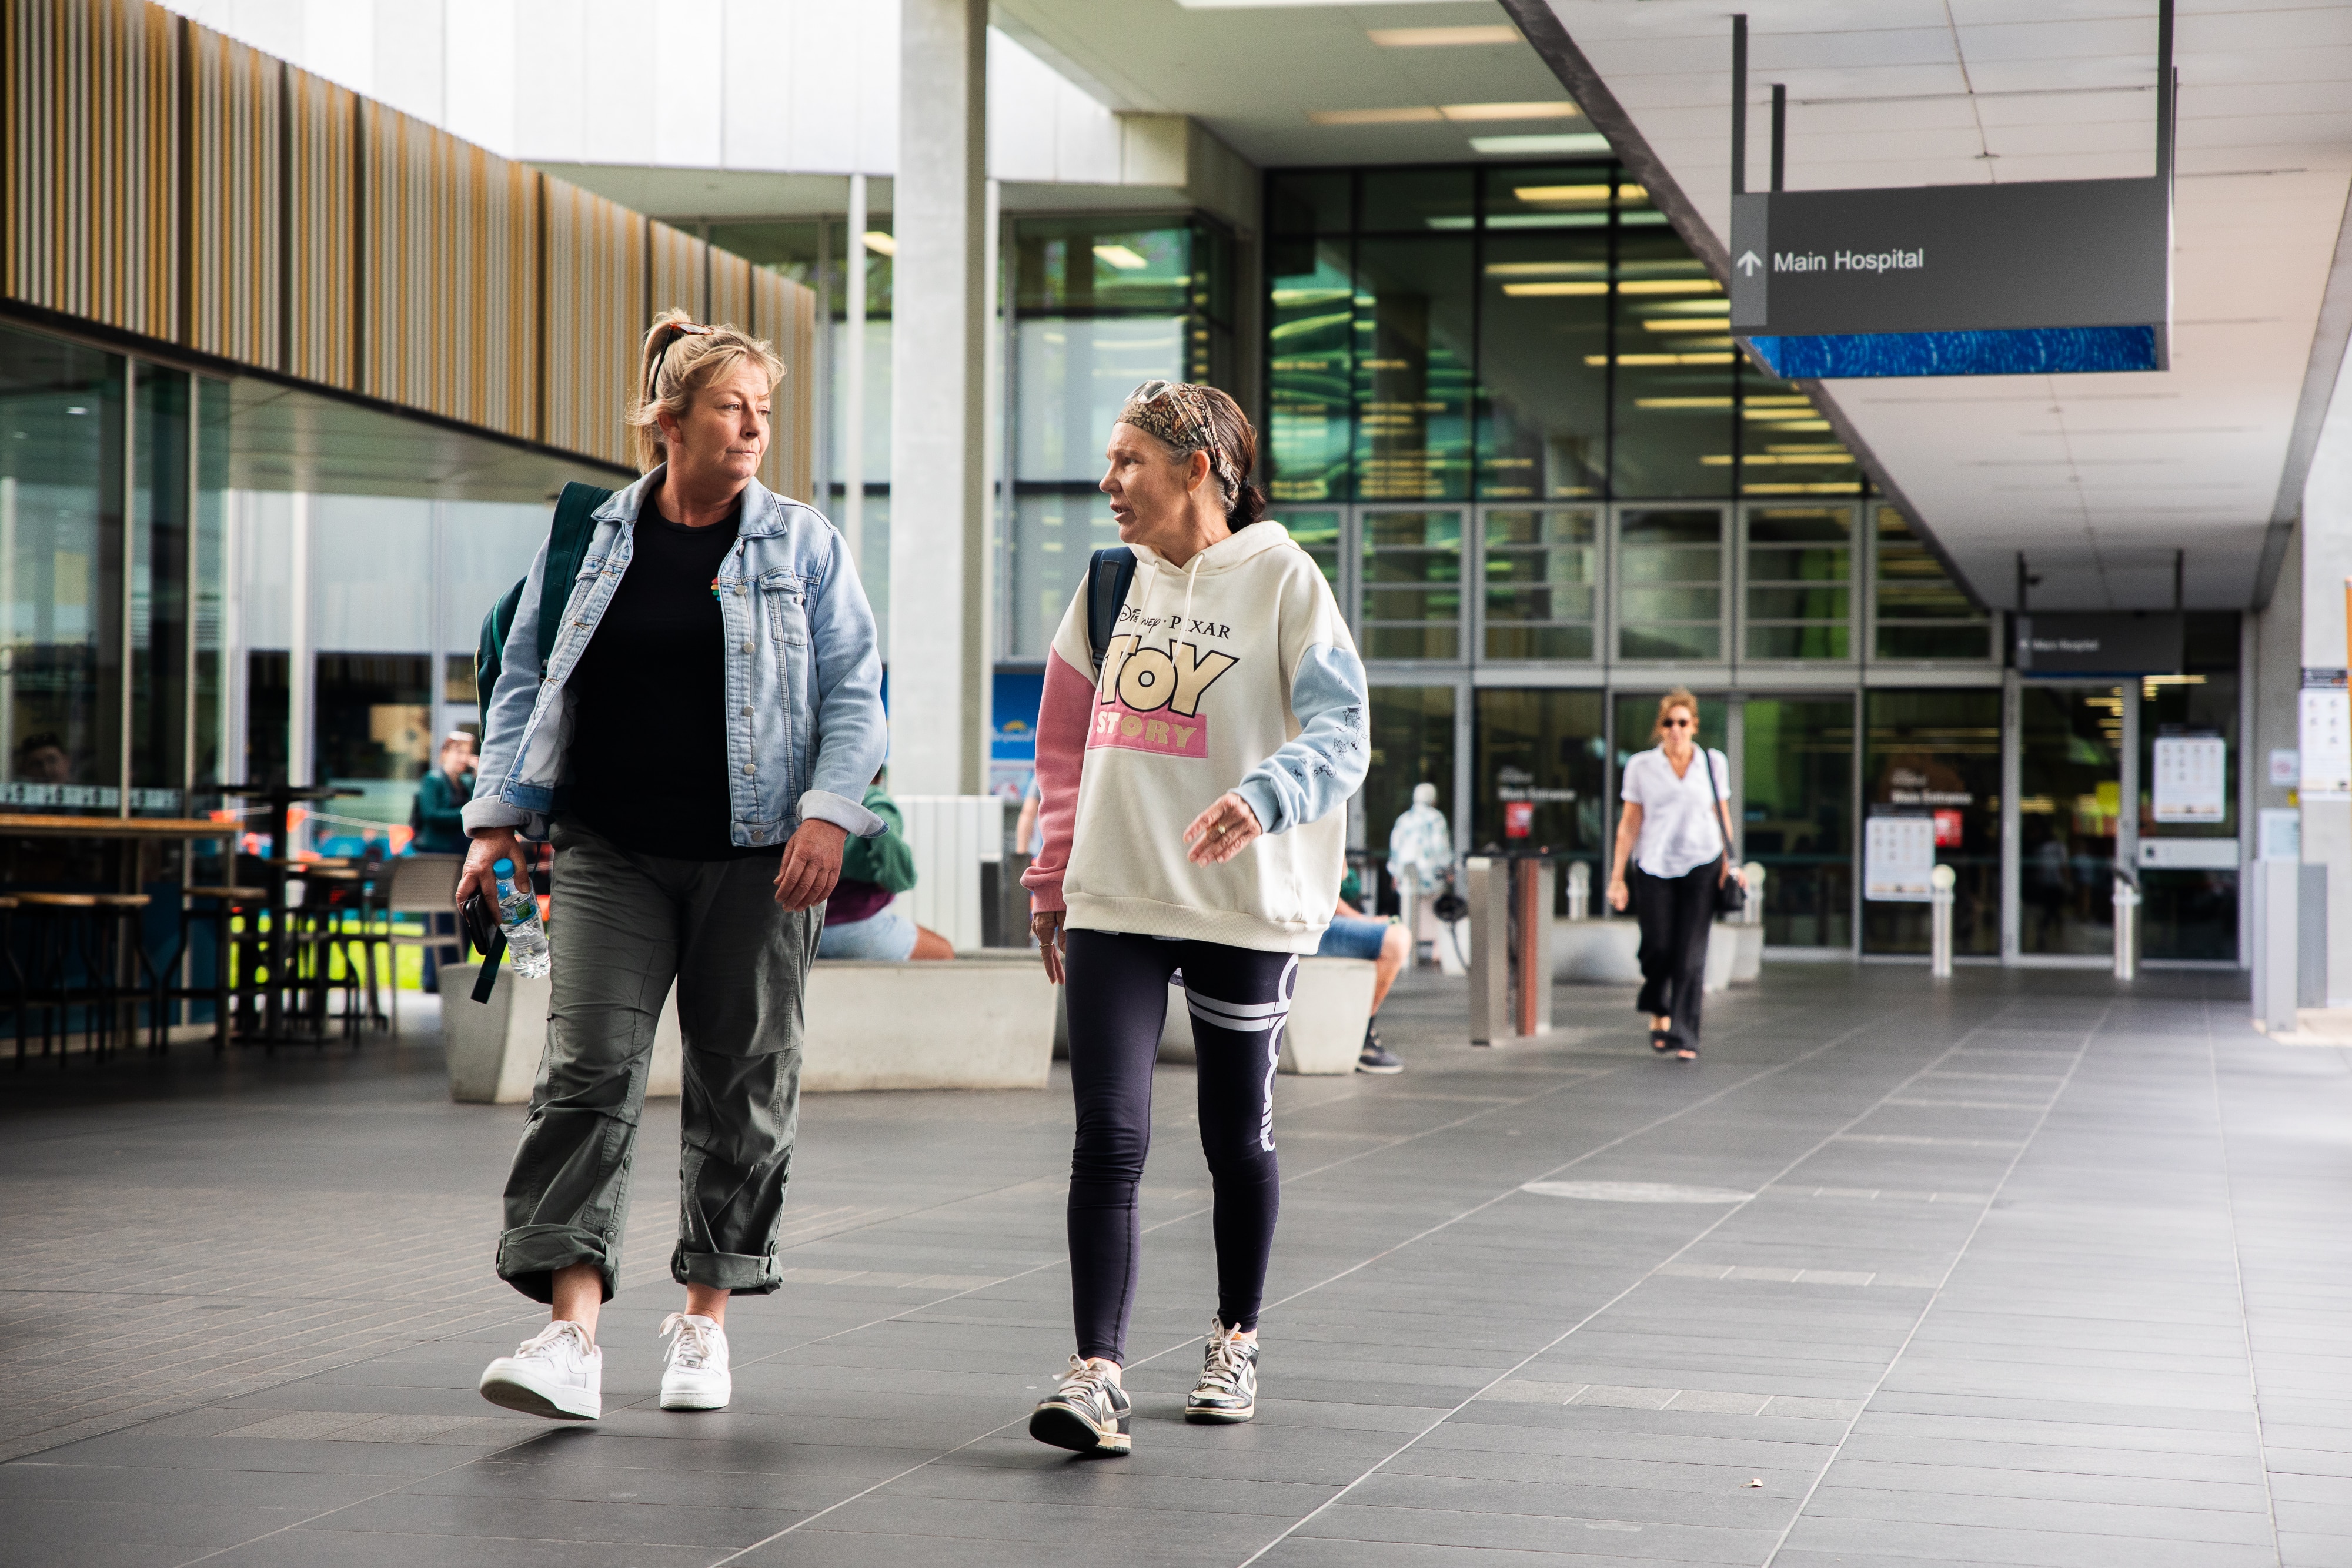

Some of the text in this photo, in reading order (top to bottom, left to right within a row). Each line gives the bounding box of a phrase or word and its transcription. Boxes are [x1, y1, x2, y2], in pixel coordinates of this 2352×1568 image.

[1773, 248, 1924, 274] Main Hospital
[1168, 615, 1230, 640] PXAR
[1101, 634, 1240, 718] TOY
[1096, 711, 1197, 748] STORY
